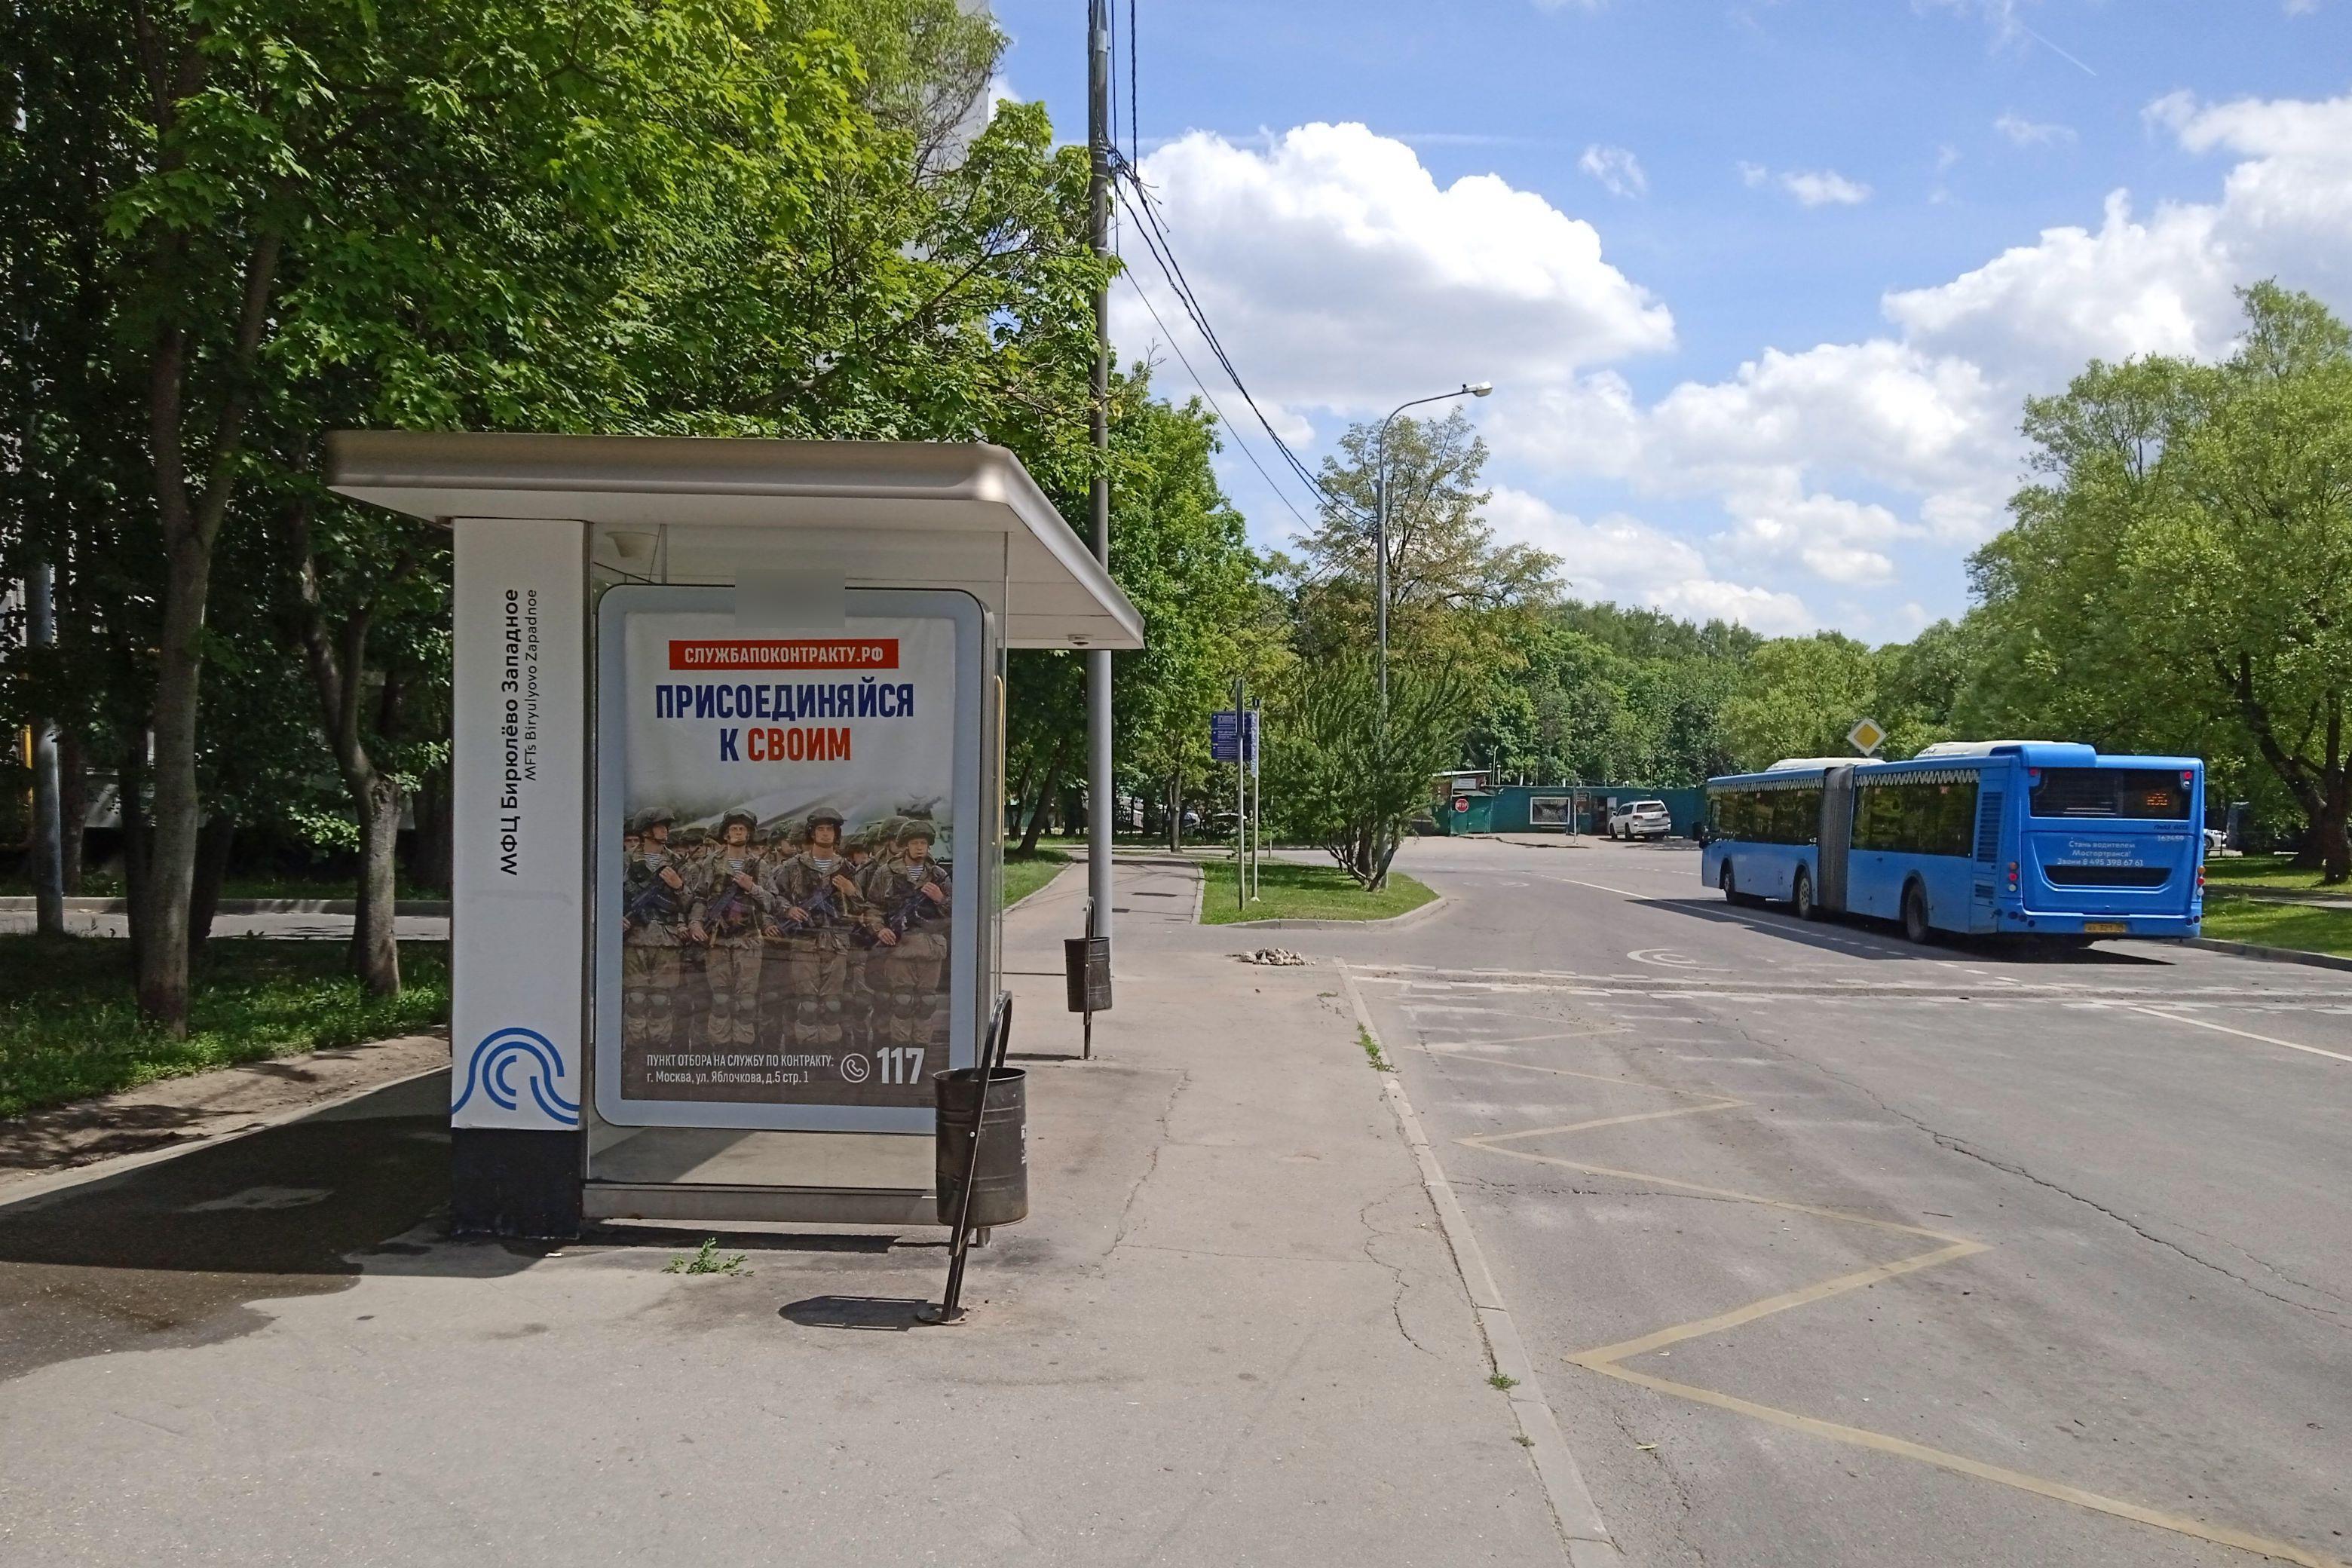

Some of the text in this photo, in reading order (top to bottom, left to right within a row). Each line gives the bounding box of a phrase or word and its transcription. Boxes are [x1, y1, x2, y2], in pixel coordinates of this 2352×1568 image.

[684, 646, 884, 663] СЛУЖБАПОКОНТРАКТУ.РФ
[525, 590, 540, 781] MFTs Biryulyovo Zapadnoe
[656, 676, 914, 721] ПРИСОЕДИНЯЙСЯ
[501, 590, 522, 876] МФЦ Бирюлёво Западное
[720, 727, 850, 761] К СВОИМ
[647, 1055, 835, 1067] ПУНКТ ОТБОРА НА СЛУЖБУ ПО КОНТРАКТУ:
[647, 1073, 654, 1083] г.
[656, 1071, 694, 1084] Москва,
[696, 1073, 709, 1085] ул.
[711, 1071, 764, 1084] Яблочкова,
[766, 1071, 781, 1084] д.5
[782, 1072, 802, 1086] стр.
[877, 1047, 925, 1084] 117
